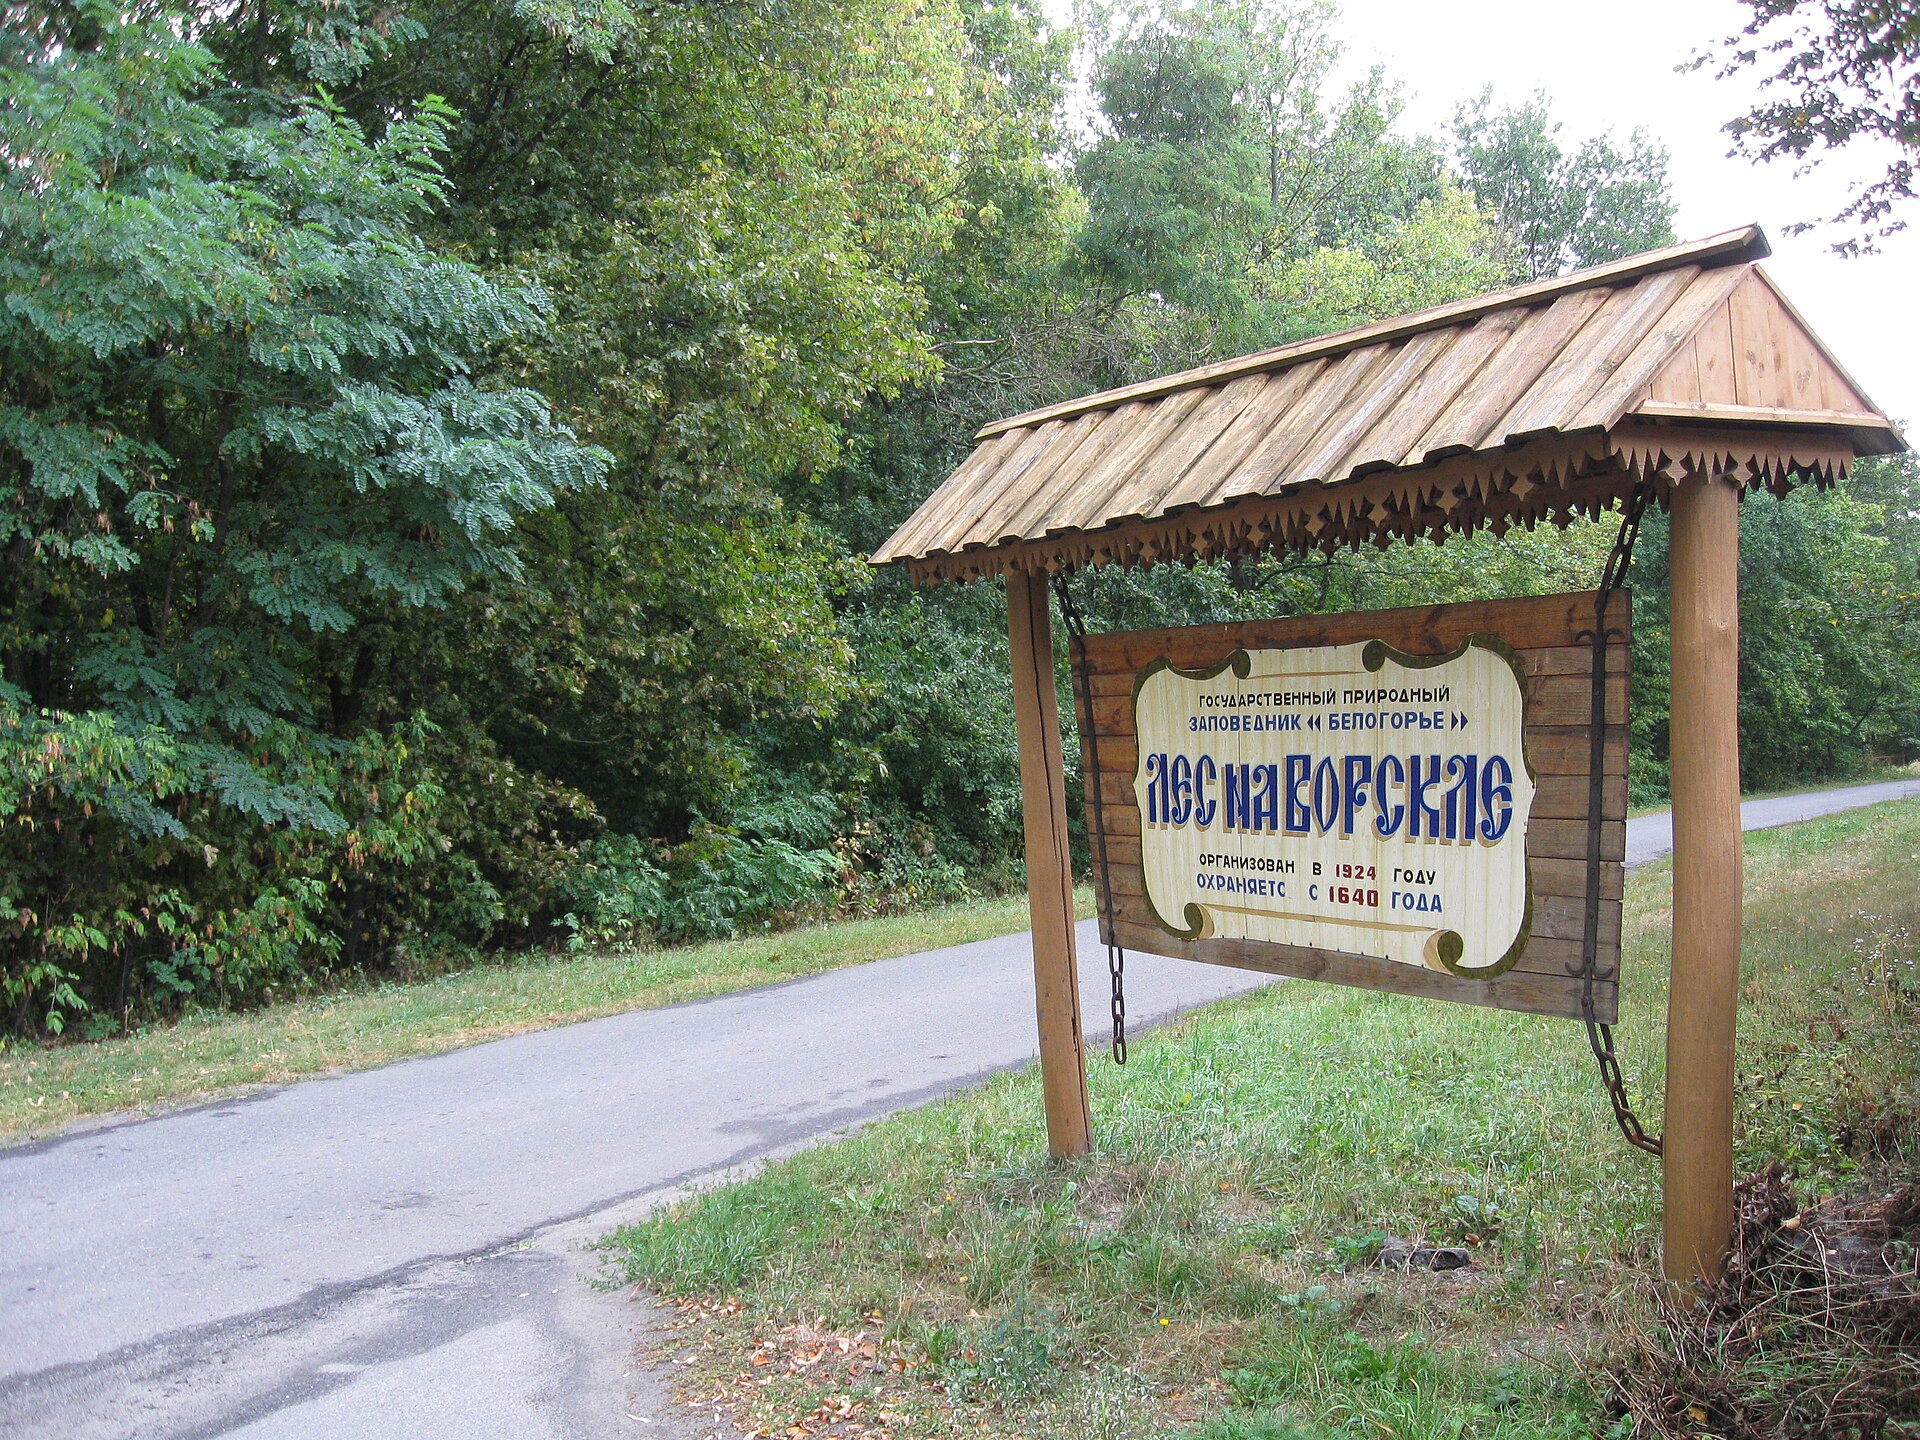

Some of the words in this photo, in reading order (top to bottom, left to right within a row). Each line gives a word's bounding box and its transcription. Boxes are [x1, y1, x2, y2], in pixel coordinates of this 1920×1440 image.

[1199, 688, 1336, 708] ГОСУДАРСТВЕННЫЙ
[1343, 684, 1450, 704] ПРИРОДНЫЙ
[1189, 714, 1302, 732] ЗАПОВЕДНИК
[1146, 753, 1217, 827] ЛЕС
[1199, 853, 1295, 874] ОРГАНИЗОВАН
[1312, 861, 1322, 876] В
[1335, 863, 1377, 881] 1924
[1393, 867, 1437, 885] ГОДУ
[1308, 883, 1318, 901] С
[1329, 885, 1379, 907] 1640
[1391, 891, 1443, 913] ГОДА
